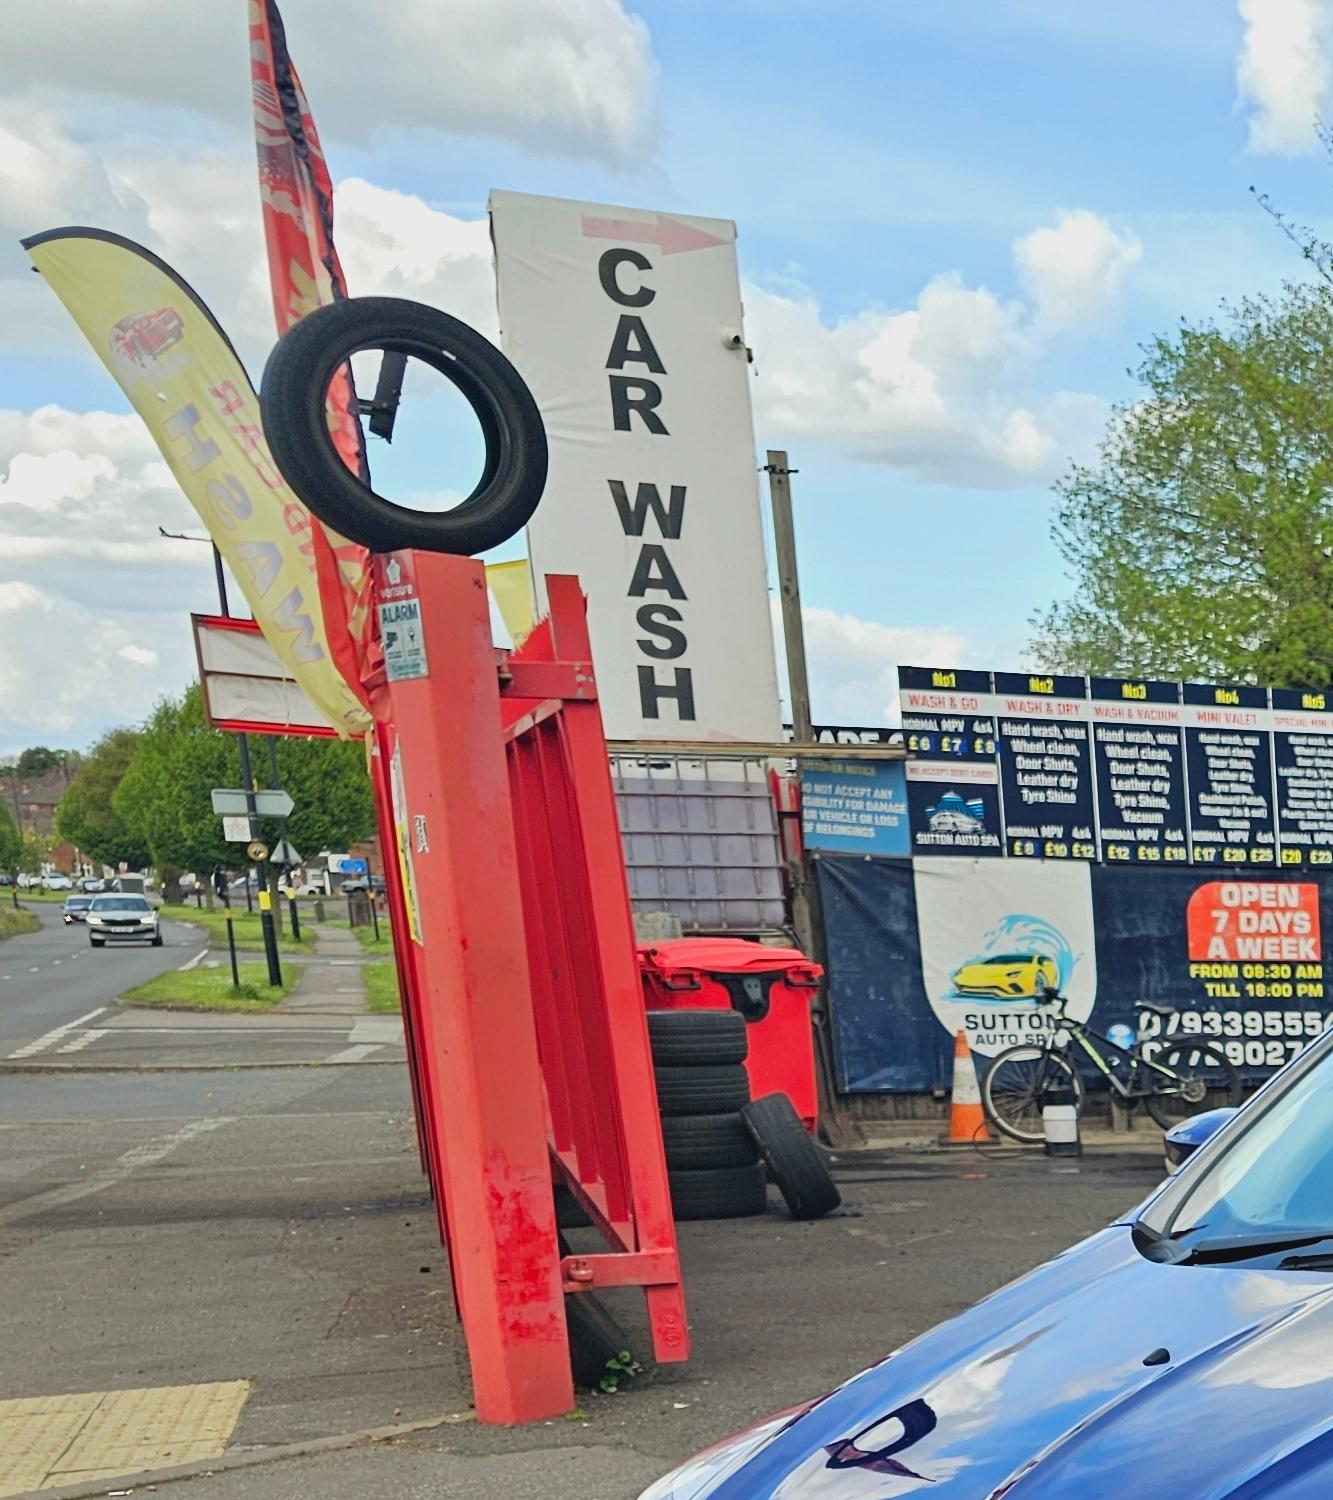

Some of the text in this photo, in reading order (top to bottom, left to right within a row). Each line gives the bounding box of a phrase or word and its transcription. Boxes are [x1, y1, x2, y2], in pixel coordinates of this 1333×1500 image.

[598, 247, 697, 721] CAR WASH
[382, 604, 418, 624] ALARM
[835, 785, 871, 797] ACCEPT
[915, 832, 954, 845] SUTTON
[1220, 883, 1299, 908] OPEN
[1210, 909, 1312, 934] 7 DAYS
[1207, 936, 1318, 960] A WEEK
[1190, 964, 1322, 979] FROM 08:30 AM
[1204, 983, 1323, 997] TILL 18:00 PM
[975, 1034, 1018, 1046] AUTO
